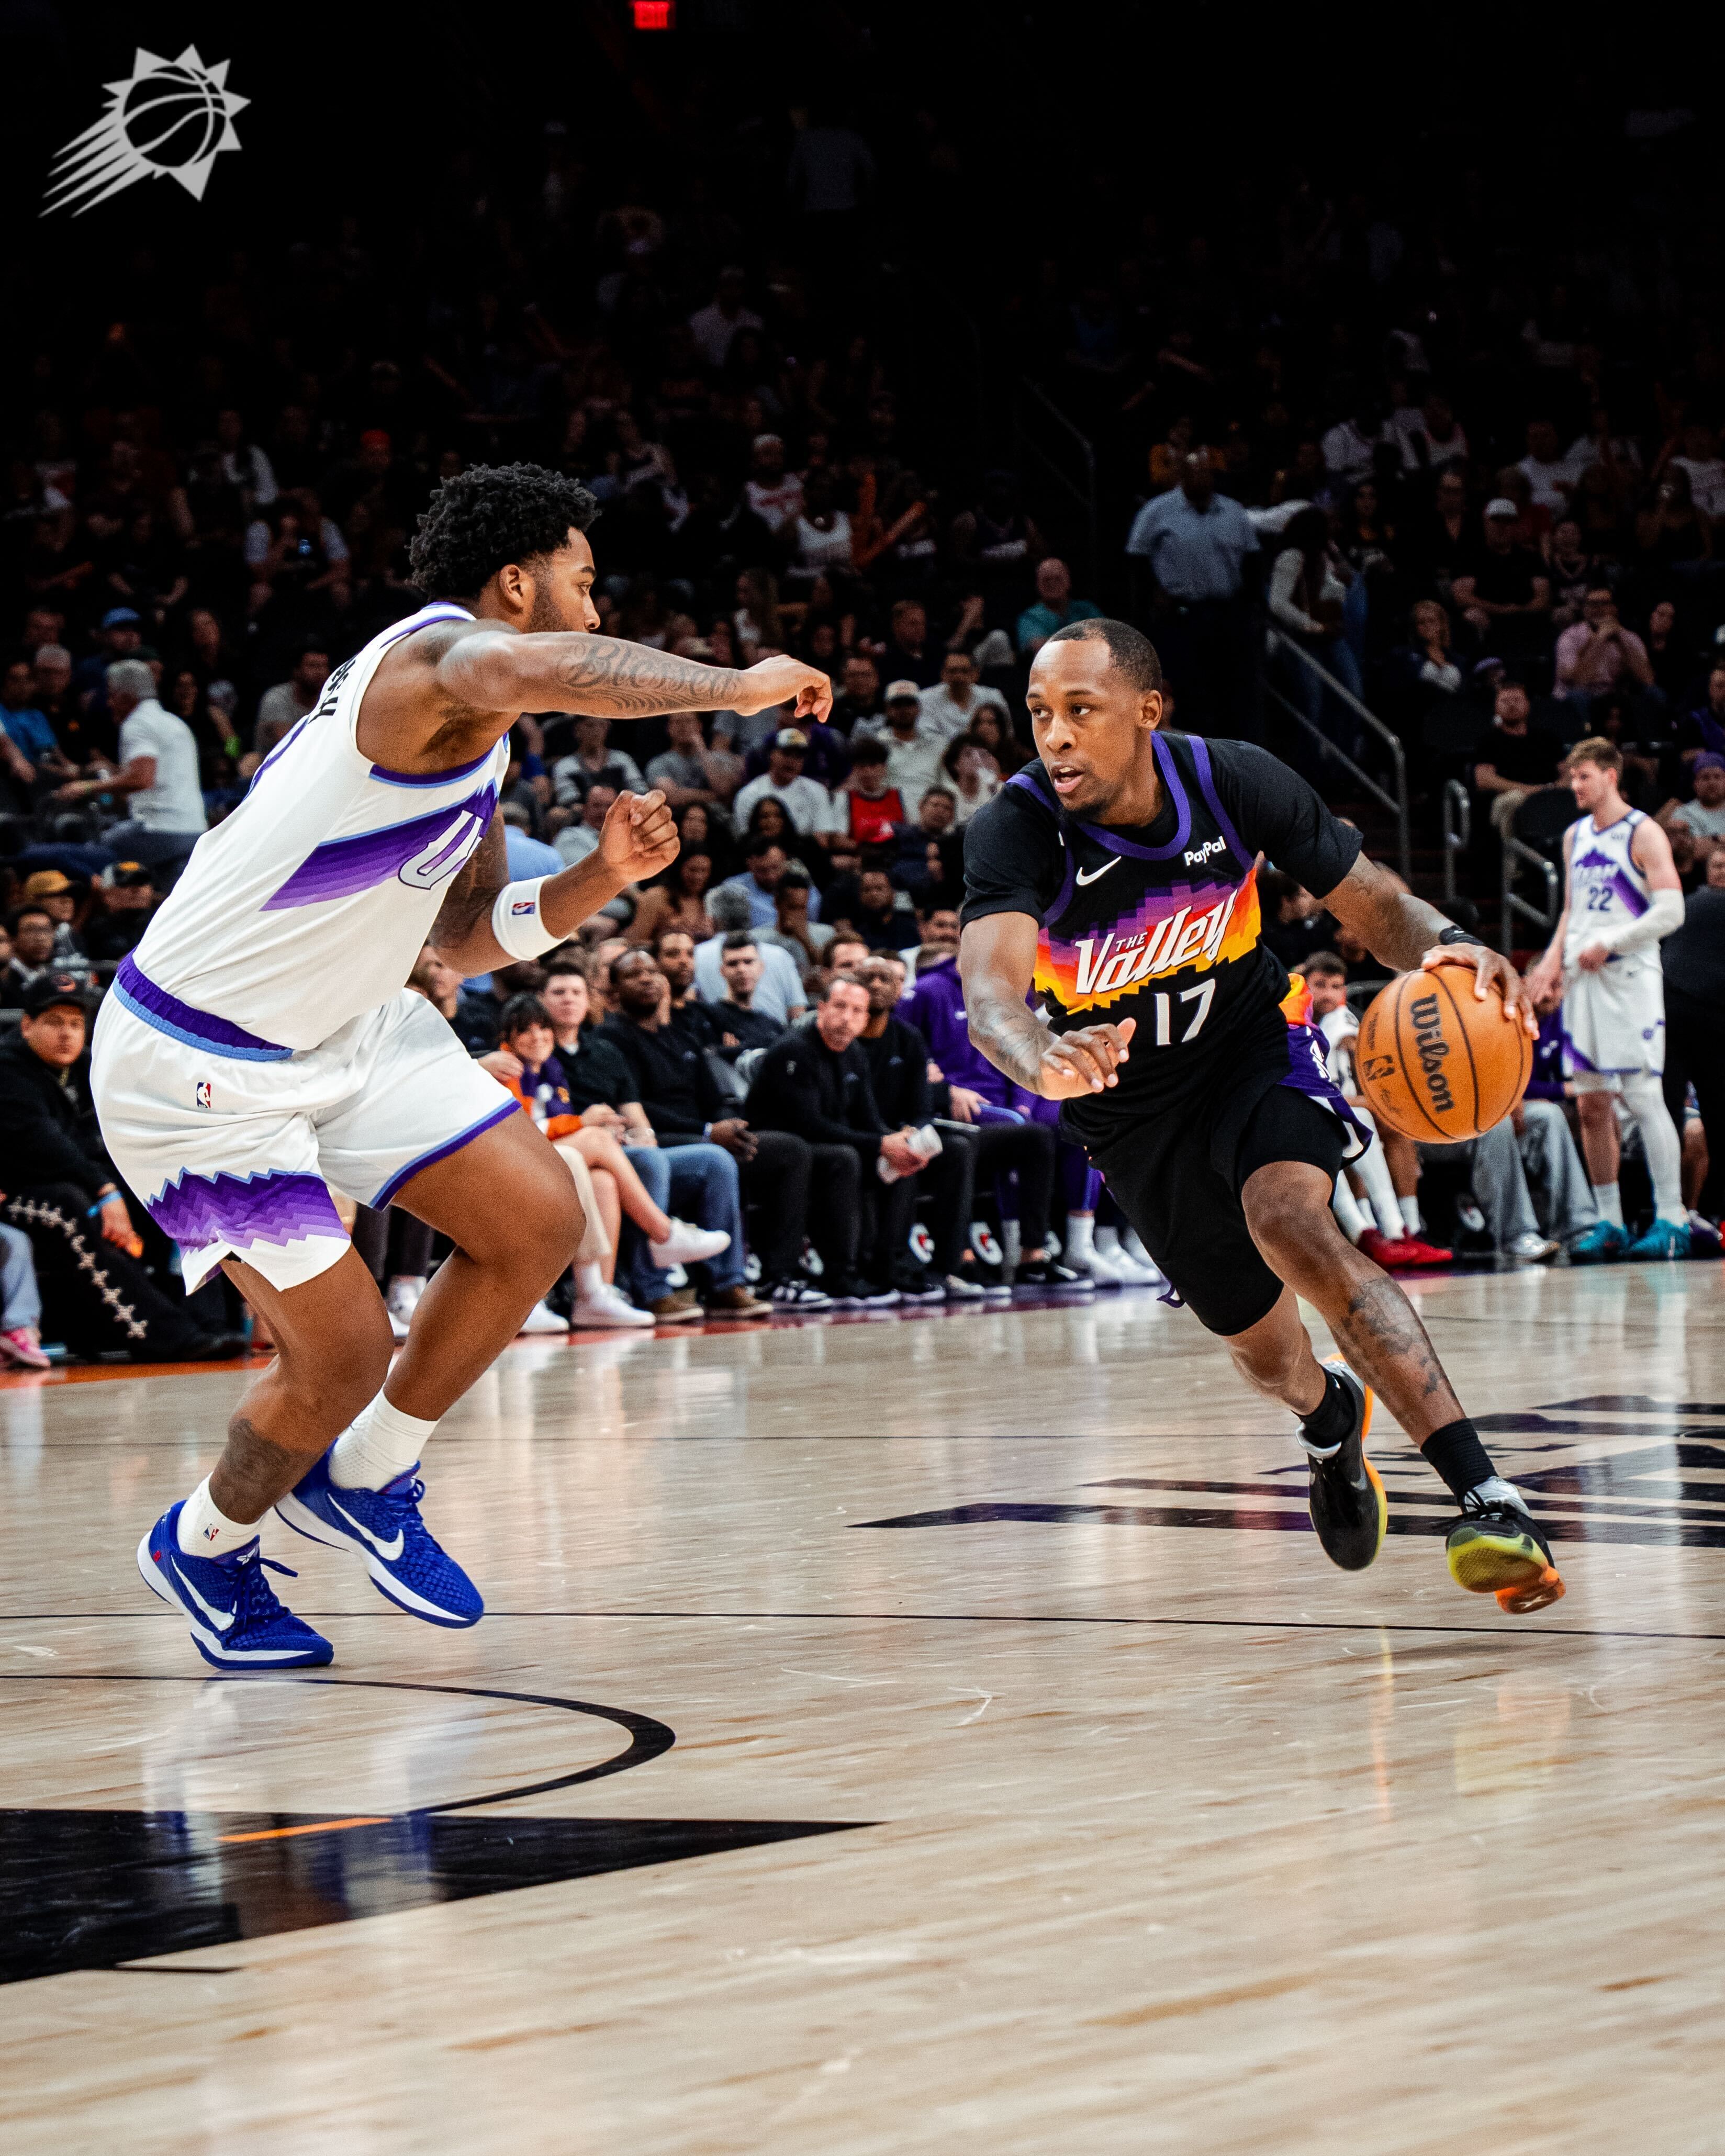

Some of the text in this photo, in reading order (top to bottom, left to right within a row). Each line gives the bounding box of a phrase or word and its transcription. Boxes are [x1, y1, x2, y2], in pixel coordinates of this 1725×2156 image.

[1184, 836, 1226, 867] PayPal
[1587, 886, 1613, 911] 22
[1075, 889, 1238, 994] Valley
[1115, 931, 1148, 952] THE
[1155, 978, 1216, 1046] 17
[1410, 993, 1455, 1114] Wilson
